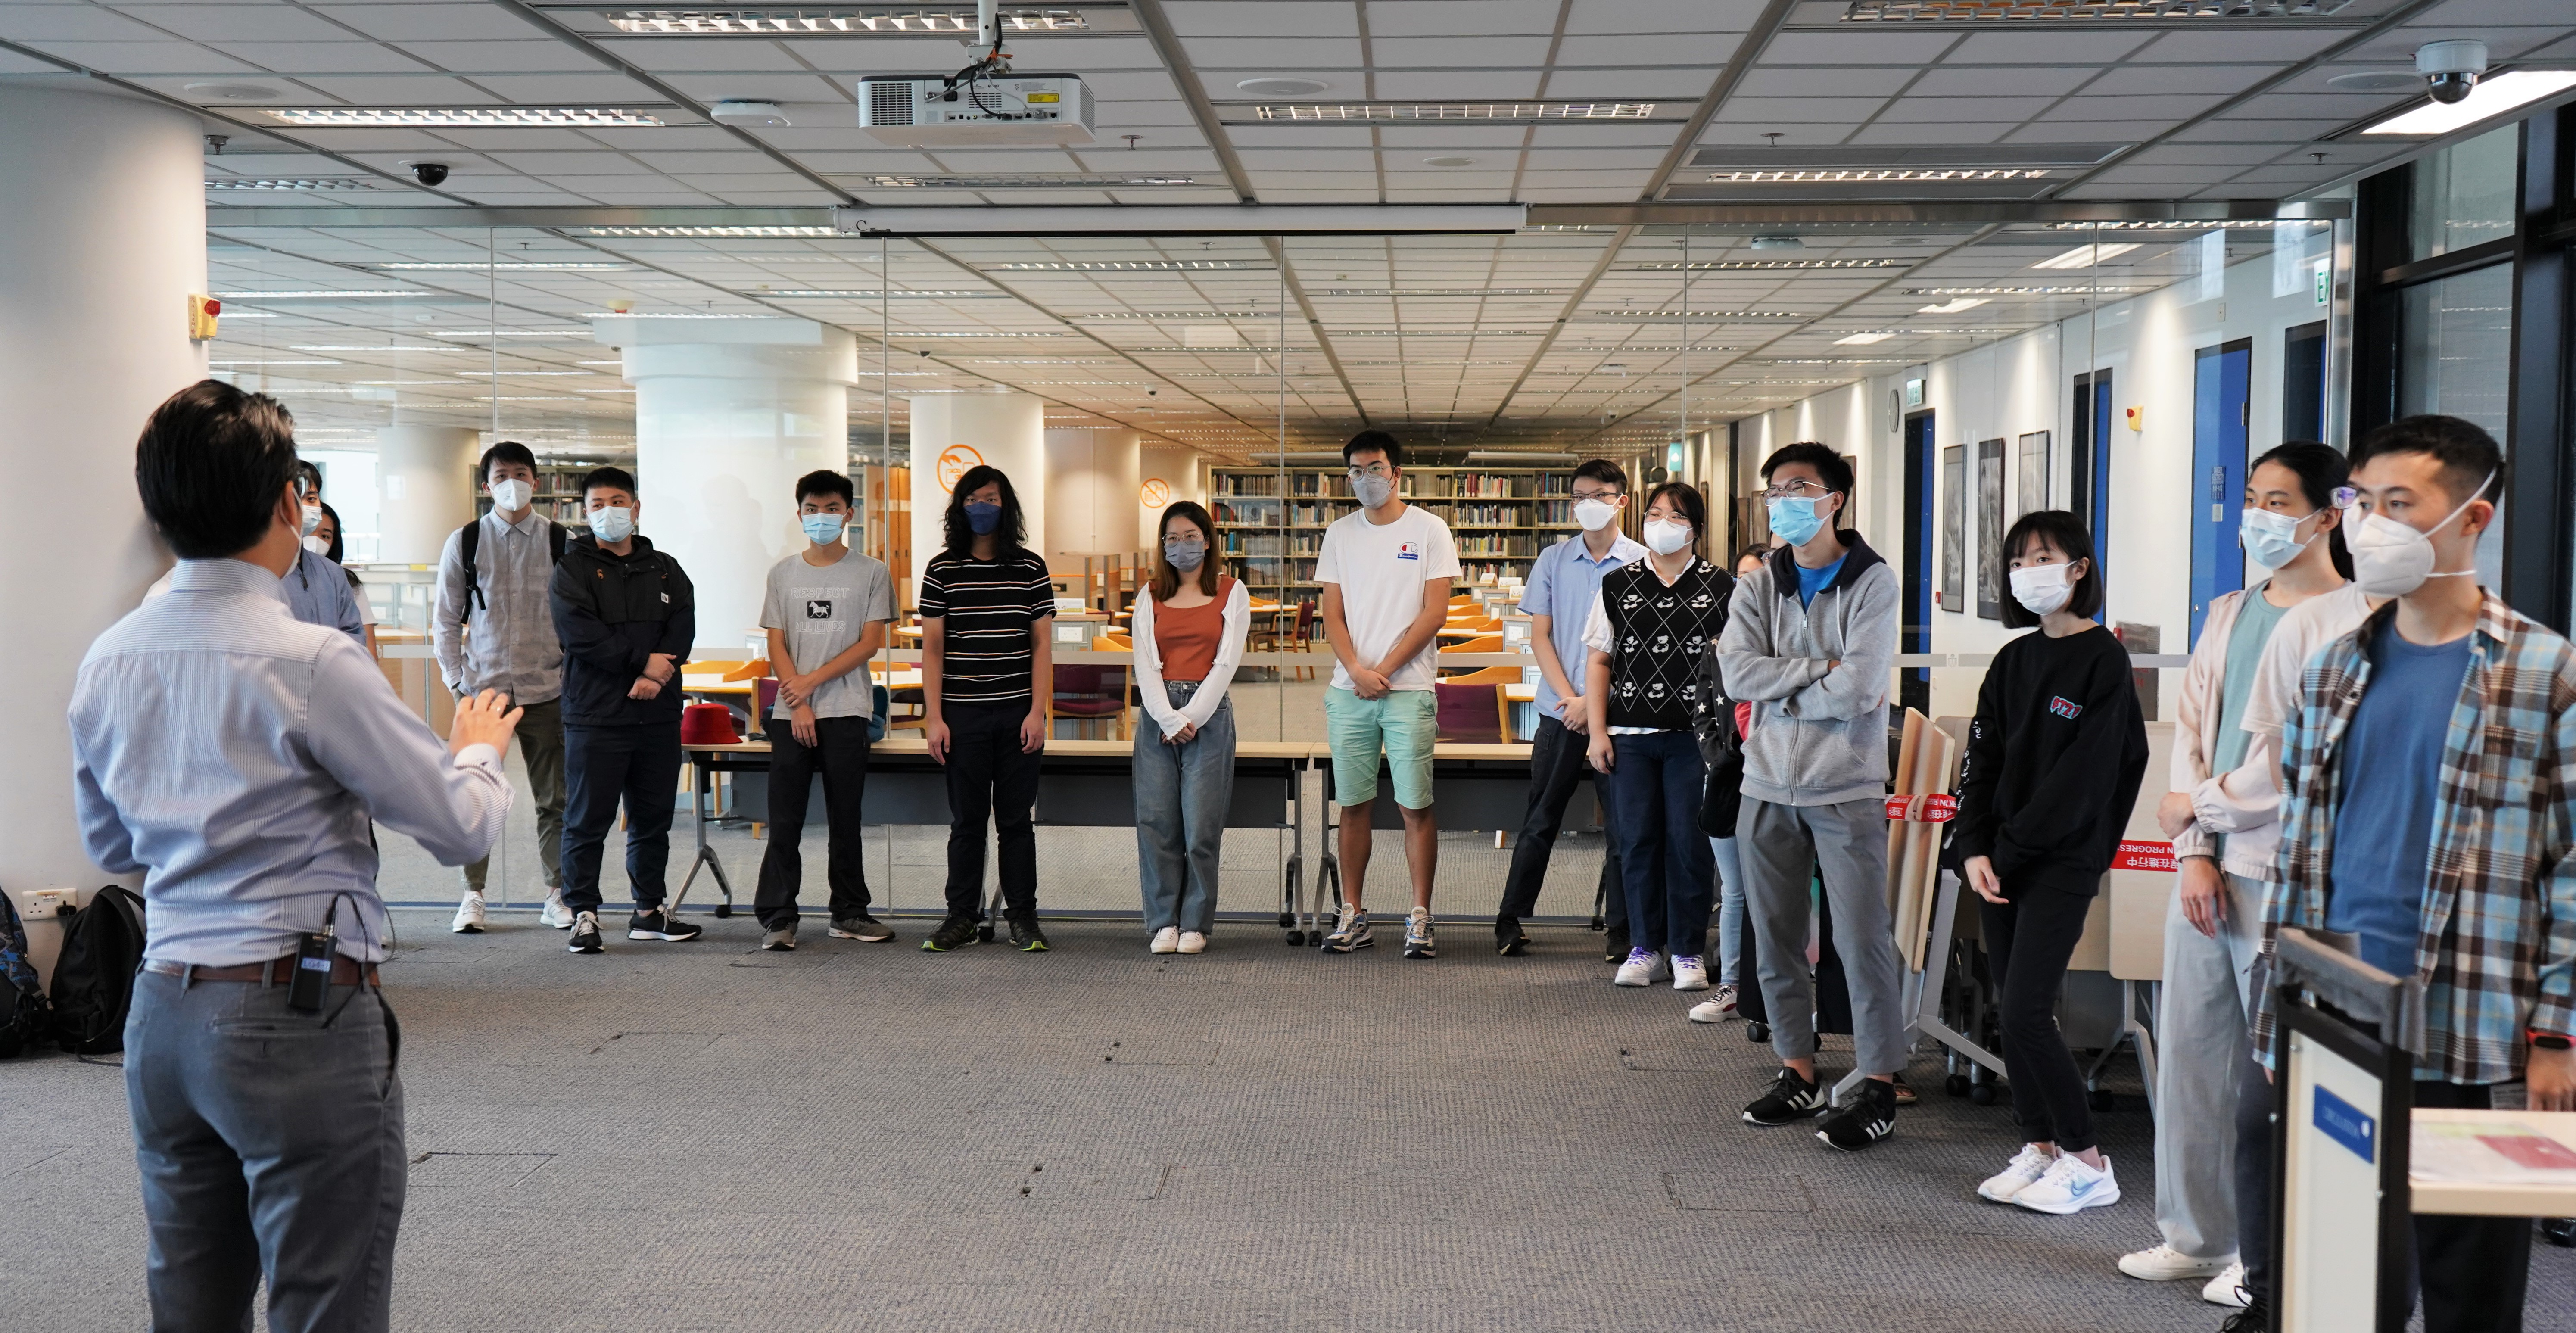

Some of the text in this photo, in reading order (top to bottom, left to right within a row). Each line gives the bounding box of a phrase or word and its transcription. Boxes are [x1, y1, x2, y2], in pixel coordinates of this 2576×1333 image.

[791, 587, 850, 599] RESPECT
[815, 620, 846, 632] LIVES
[2050, 695, 2083, 720] BT21
[2117, 844, 2165, 854] PROGRES
